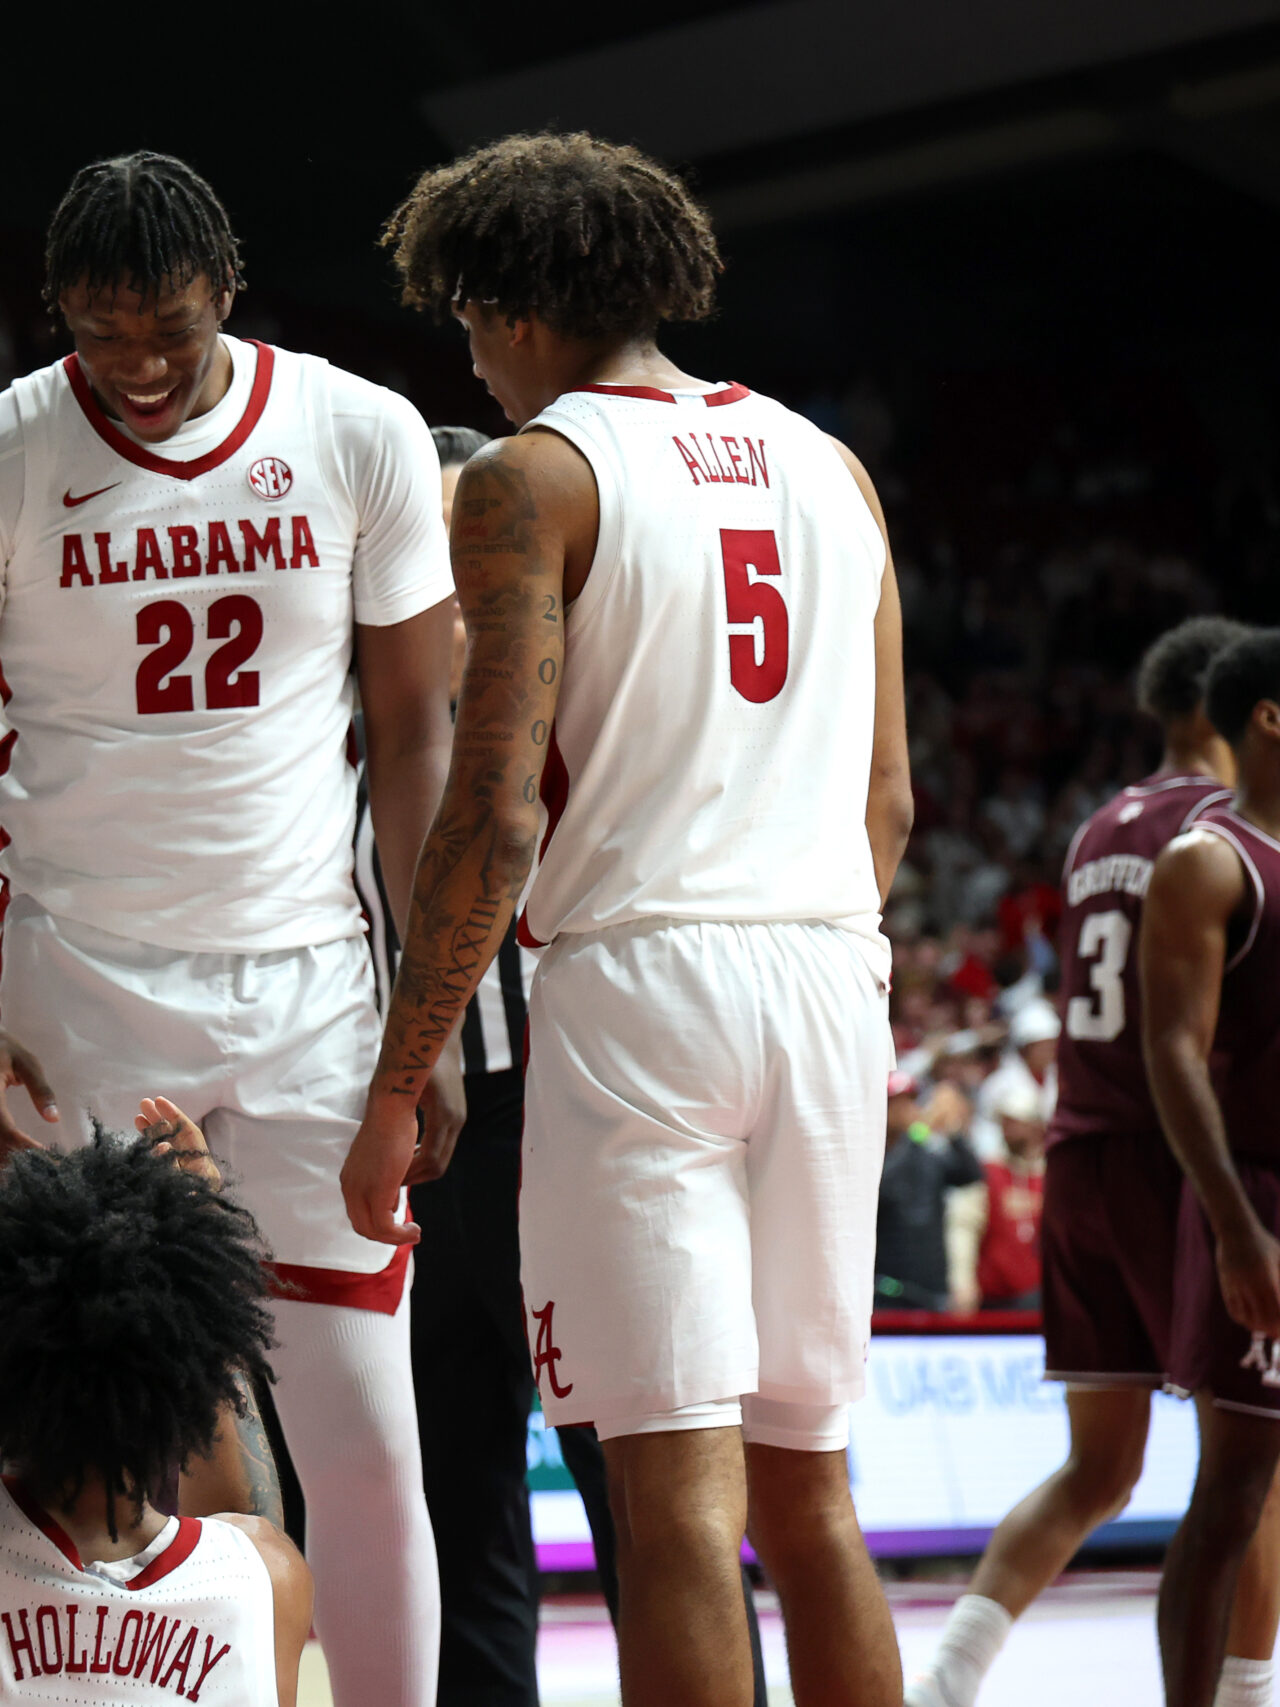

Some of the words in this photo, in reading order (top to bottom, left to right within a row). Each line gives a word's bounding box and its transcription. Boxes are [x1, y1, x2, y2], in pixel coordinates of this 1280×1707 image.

[250, 457, 292, 498] SEC
[672, 432, 770, 489] ALLEN
[60, 515, 320, 588] ALABAMA
[136, 594, 264, 714] 22
[719, 528, 789, 704] 5
[1066, 910, 1132, 1042] 3
[531, 1300, 573, 1401] A
[1, 1604, 231, 1703] HOLLOWAY
